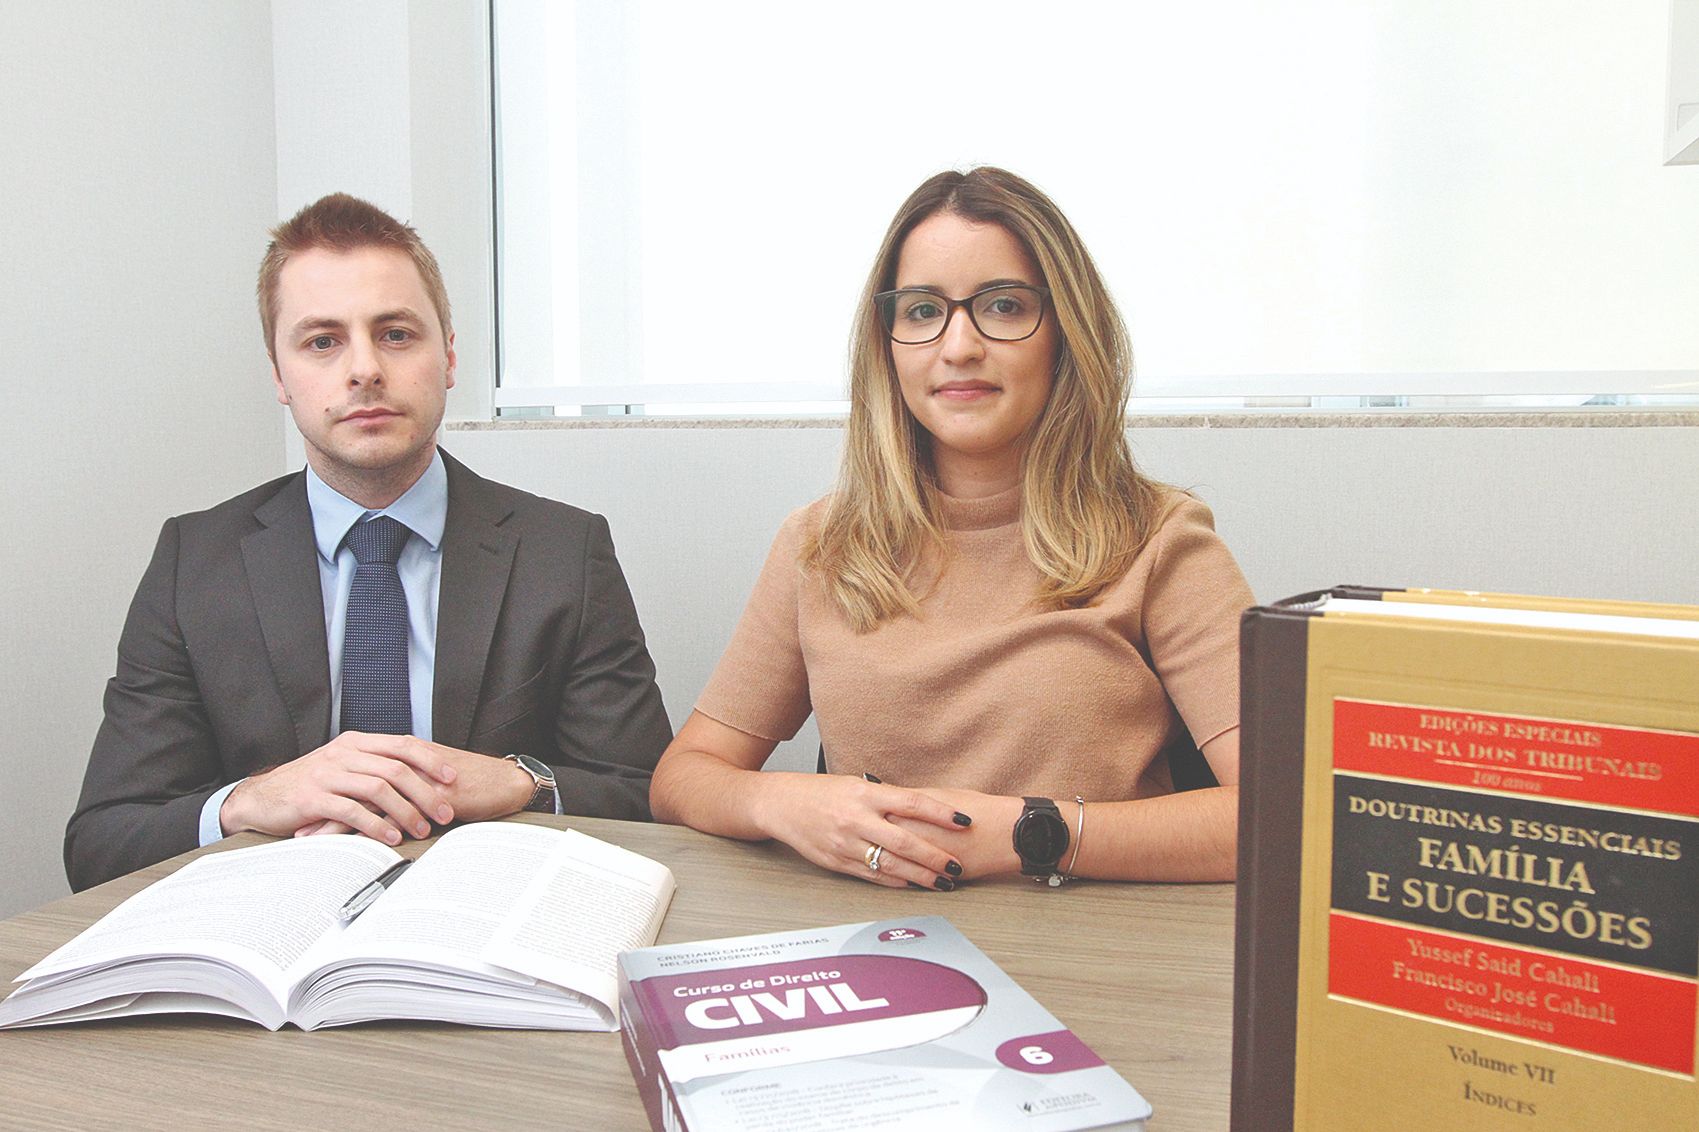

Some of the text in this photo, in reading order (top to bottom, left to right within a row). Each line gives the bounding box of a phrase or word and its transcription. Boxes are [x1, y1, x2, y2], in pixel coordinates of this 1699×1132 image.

[1503, 722, 1602, 748] ESPECIAIS
[1368, 731, 1663, 781] REVISTA DOS TRIBUNAIS
[1348, 796, 1683, 862] DOUTRINAS ESSENCIAIS
[1417, 837, 1597, 895] FAMÍLIA
[1366, 871, 1654, 950] E SUCESSÕES
[659, 958, 708, 968] NELSON
[722, 943, 769, 955] CHAVES
[788, 938, 830, 947] FARIAS
[1406, 938, 1601, 993] Yussef Said Cahali
[672, 969, 842, 998] Curso de Direito
[1392, 961, 1617, 1025] Francisco José Cahali
[684, 982, 890, 1030] CIVIL
[1443, 997, 1554, 1033] Organizadores
[1019, 1045, 1054, 1065] 6
[1447, 1045, 1556, 1085] Volume VII
[1463, 1080, 1537, 1117] ÍNDICES
